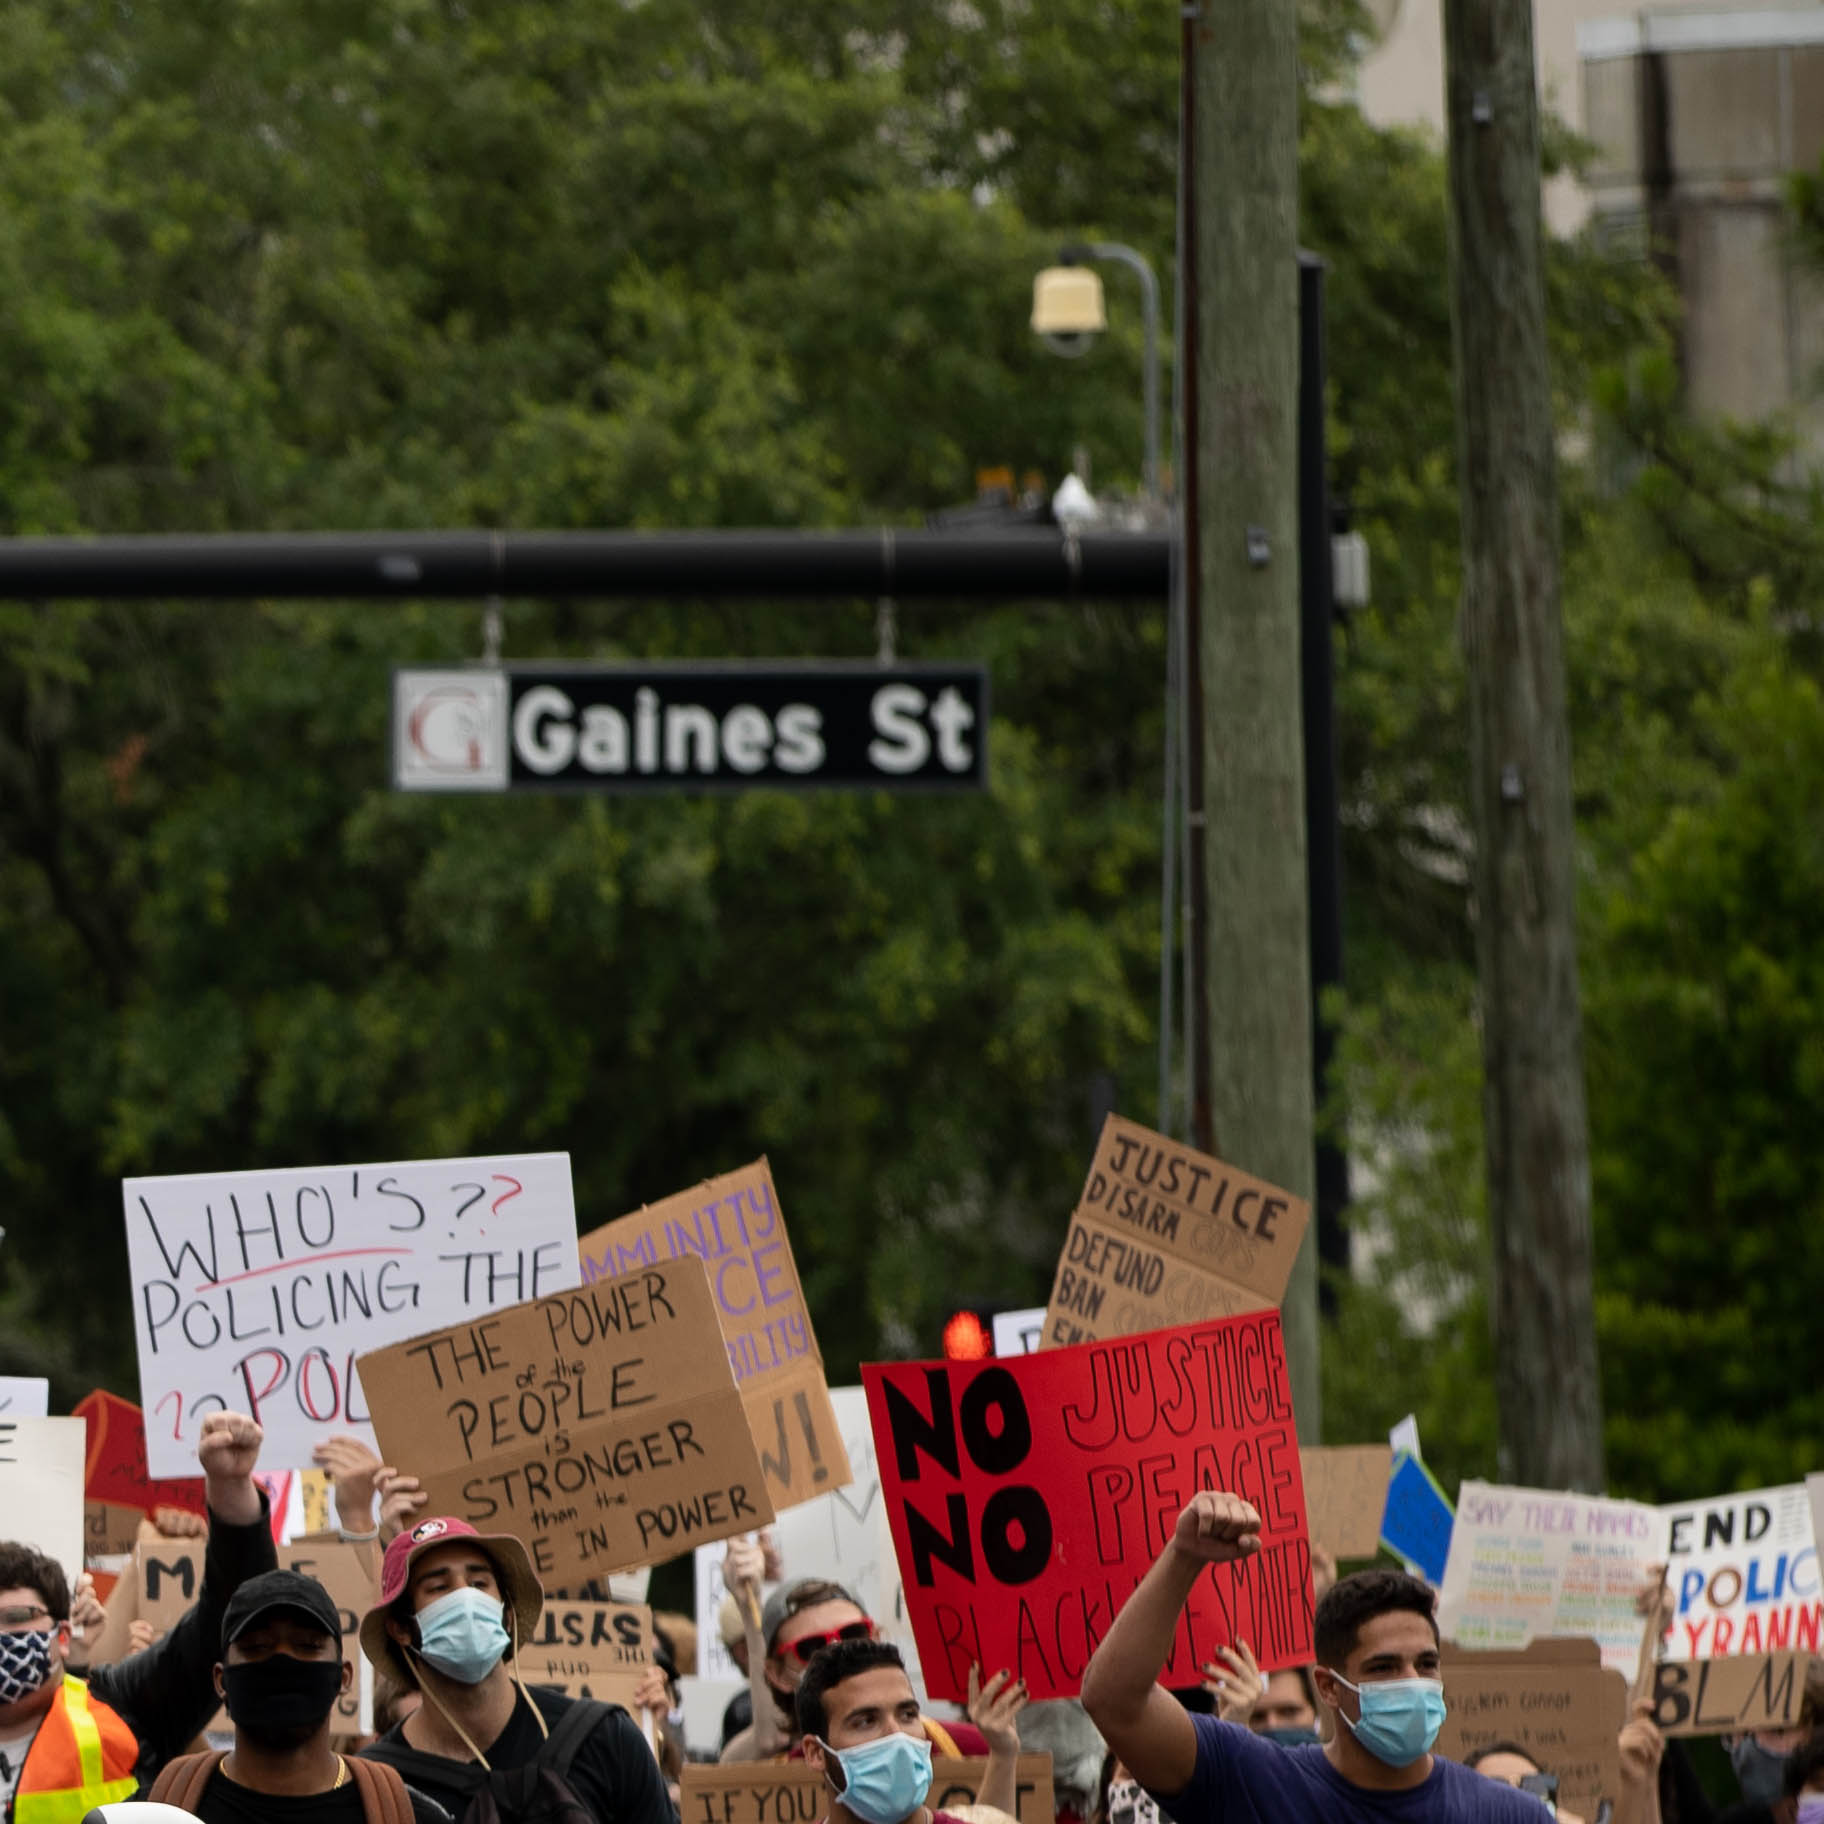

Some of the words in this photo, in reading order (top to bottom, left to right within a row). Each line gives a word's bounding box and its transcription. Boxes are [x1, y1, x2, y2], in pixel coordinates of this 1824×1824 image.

[513, 684, 827, 775] Gaines
[867, 683, 975, 774] St
[1085, 1172, 1181, 1242] DISARM
[1108, 1131, 1290, 1243] JUSTICE
[142, 1260, 421, 1354] POLICING
[438, 1241, 563, 1306] THE
[1056, 1265, 1108, 1324] BAN
[1066, 1223, 1165, 1296] DEFUND
[406, 1320, 511, 1391] THE
[534, 1271, 678, 1354] POWER
[446, 1357, 658, 1462] PEOPLE
[515, 1364, 537, 1389] of
[550, 1355, 586, 1379] the
[1061, 1317, 1293, 1453] JUSTICE
[544, 1428, 570, 1457] is
[881, 1365, 1033, 1483] NO
[462, 1418, 705, 1523] STRONGER
[530, 1505, 579, 1530] than
[595, 1491, 630, 1511] the
[576, 1525, 609, 1561] IN
[635, 1484, 757, 1552] POWER
[900, 1484, 1054, 1589] NO
[1462, 1494, 1512, 1528] SAY
[1587, 1507, 1650, 1538] NAMES
[1669, 1503, 1772, 1554] END
[1653, 1655, 1795, 1727] BLM
